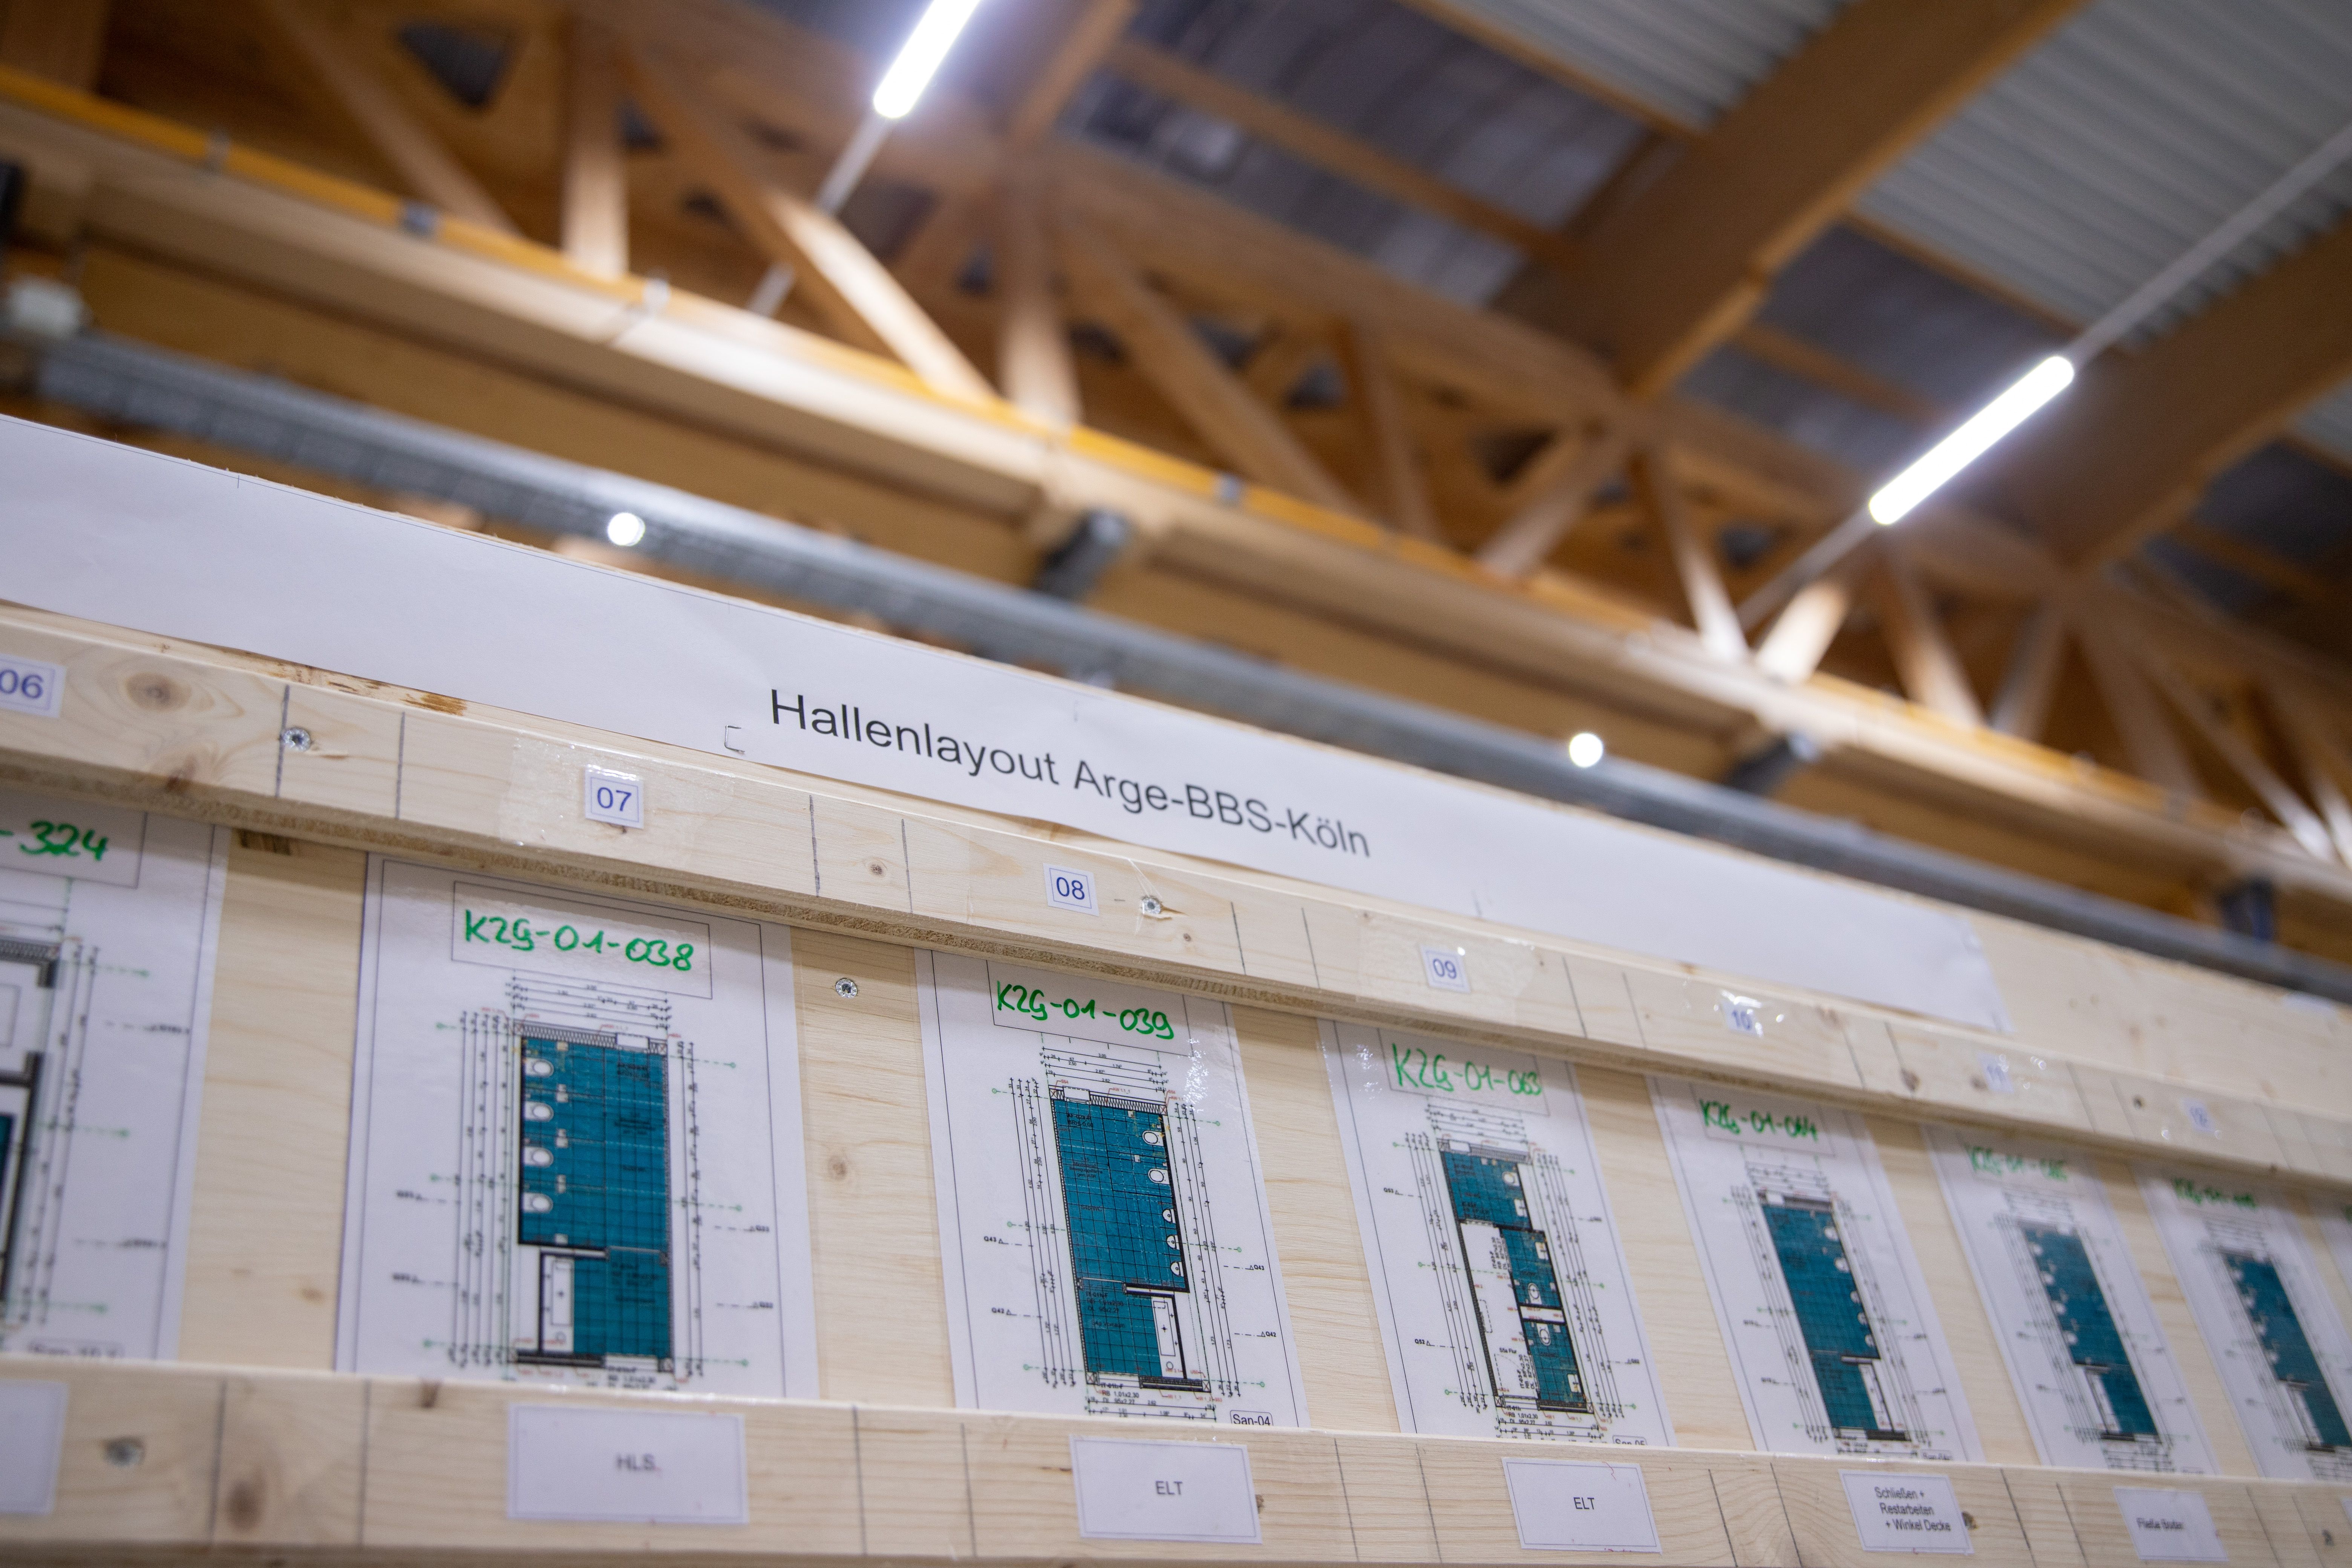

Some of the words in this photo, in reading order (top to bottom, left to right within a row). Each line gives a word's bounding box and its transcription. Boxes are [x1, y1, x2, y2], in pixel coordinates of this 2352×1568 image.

[0, 669, 44, 700] 06
[771, 688, 1060, 786] Hallenlayout
[1073, 760, 1370, 858] Arge-BBS-Köln
[597, 787, 632, 812] 07
[1056, 876, 1085, 900] 08
[1433, 958, 1457, 979] 09
[1233, 1414, 1270, 1426] San-04
[616, 1453, 655, 1472] HLS
[1155, 1480, 1183, 1496] ELT
[1874, 1486, 1918, 1499] Schließen
[1573, 1497, 1595, 1510] ELT
[1879, 1502, 1934, 1515] Restarbeiten
[1892, 1519, 1922, 1531] Winkel
[1924, 1519, 1951, 1532] Decke
